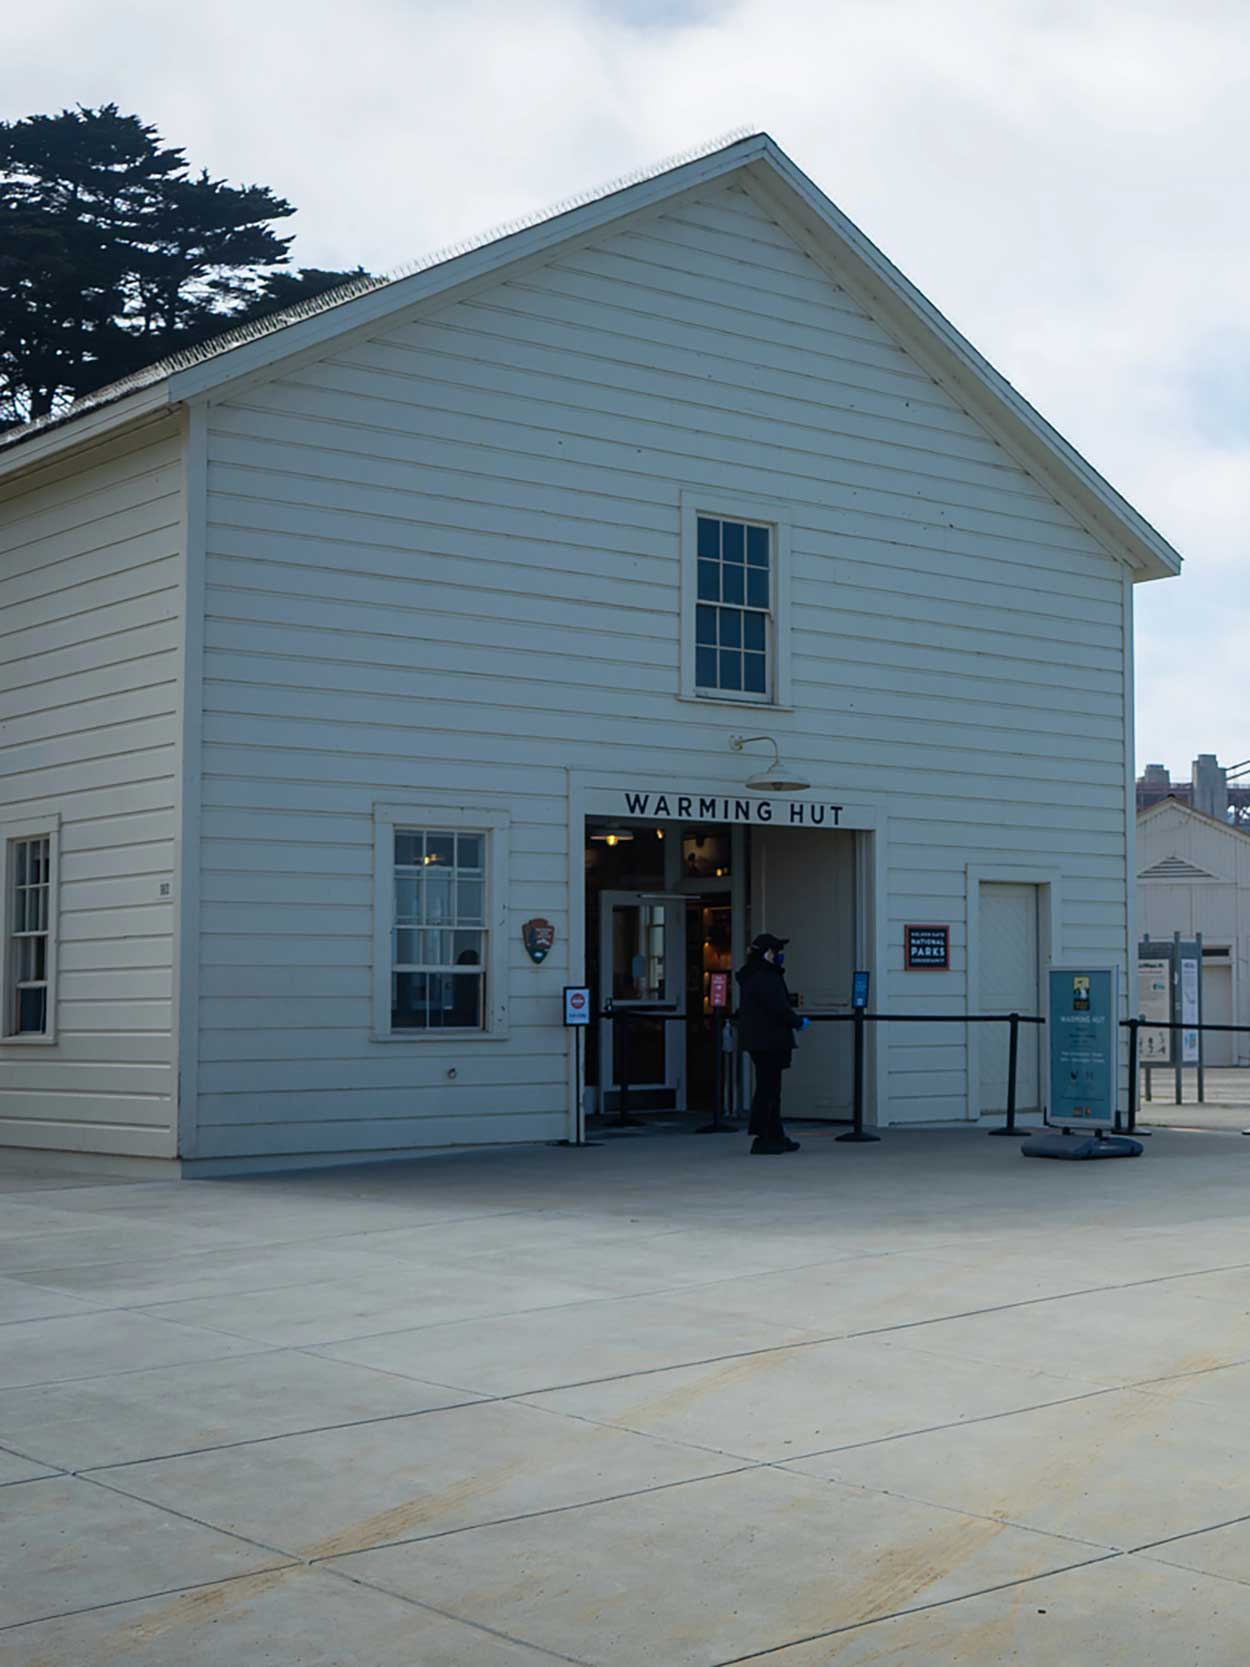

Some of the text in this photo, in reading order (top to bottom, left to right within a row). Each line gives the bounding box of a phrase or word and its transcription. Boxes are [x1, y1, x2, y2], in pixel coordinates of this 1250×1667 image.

[624, 792, 844, 826] WARMING HUT
[911, 946, 945, 956] PARKS
